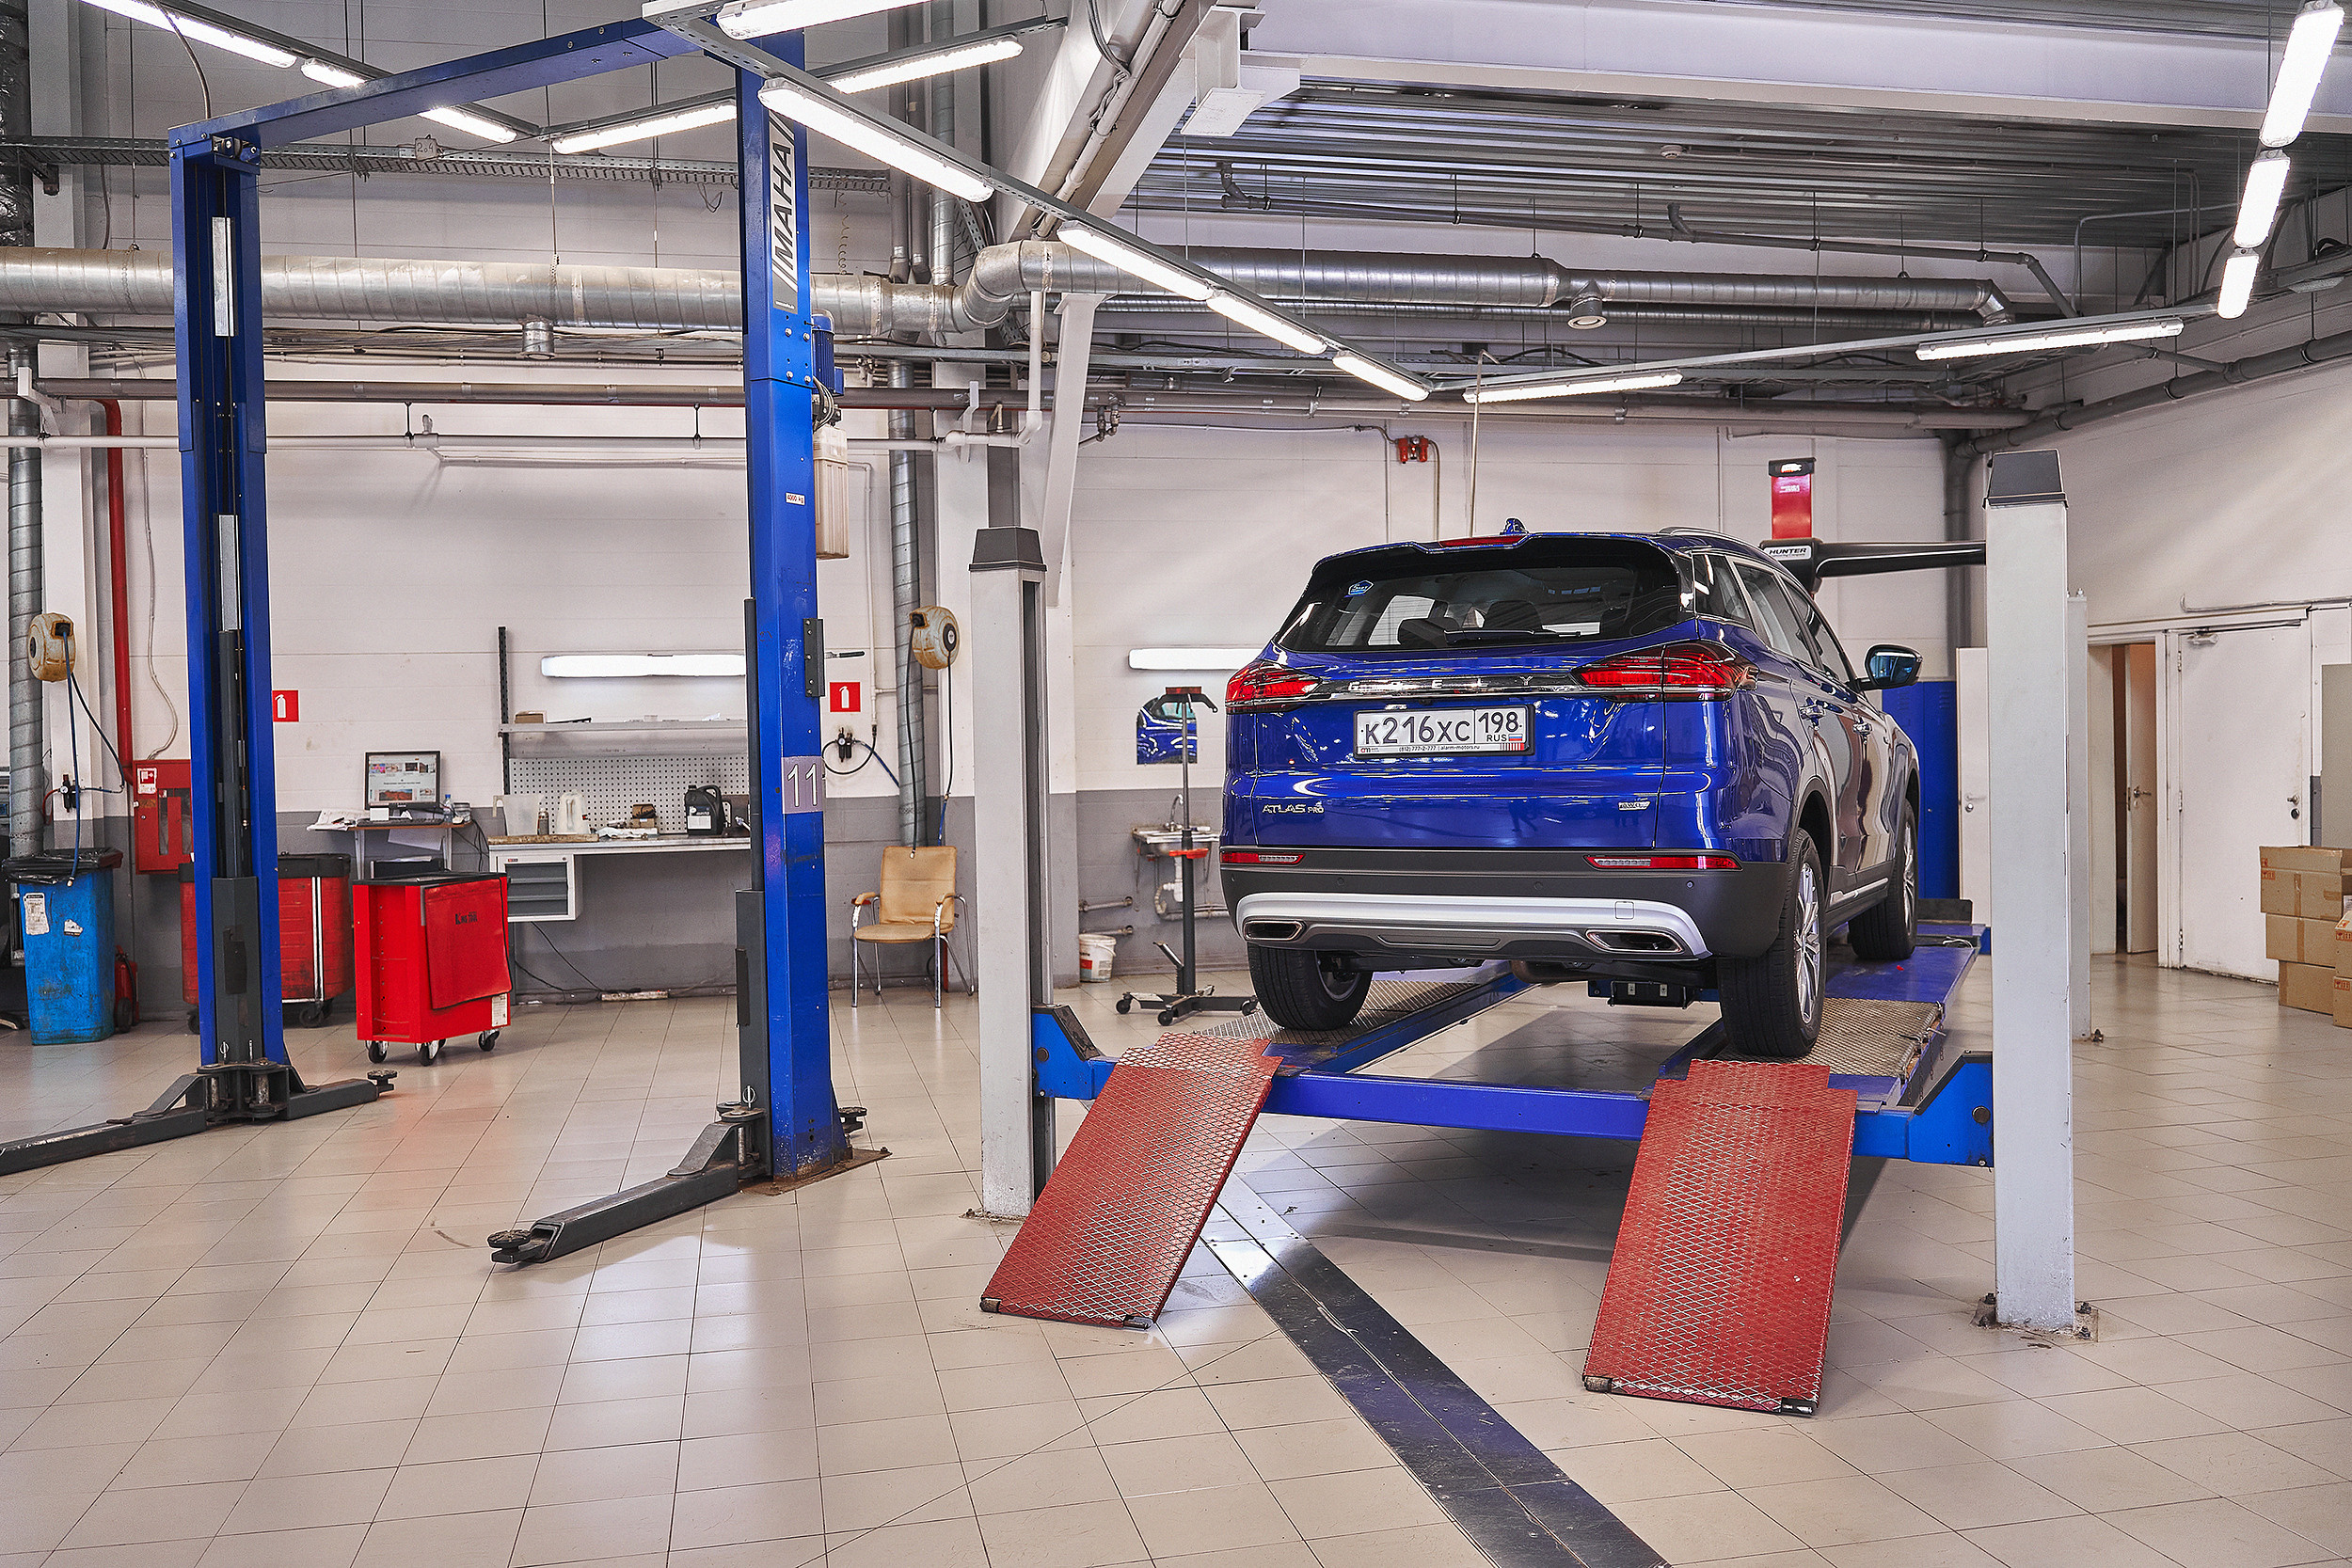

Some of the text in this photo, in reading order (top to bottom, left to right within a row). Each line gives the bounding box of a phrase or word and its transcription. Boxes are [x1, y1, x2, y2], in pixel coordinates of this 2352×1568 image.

[772, 142, 794, 271] MAHA
[1348, 675, 1534, 691] GELY
[1478, 712, 1518, 733] 198
[787, 763, 818, 807] 11
[1262, 804, 1306, 814] ATLAS
